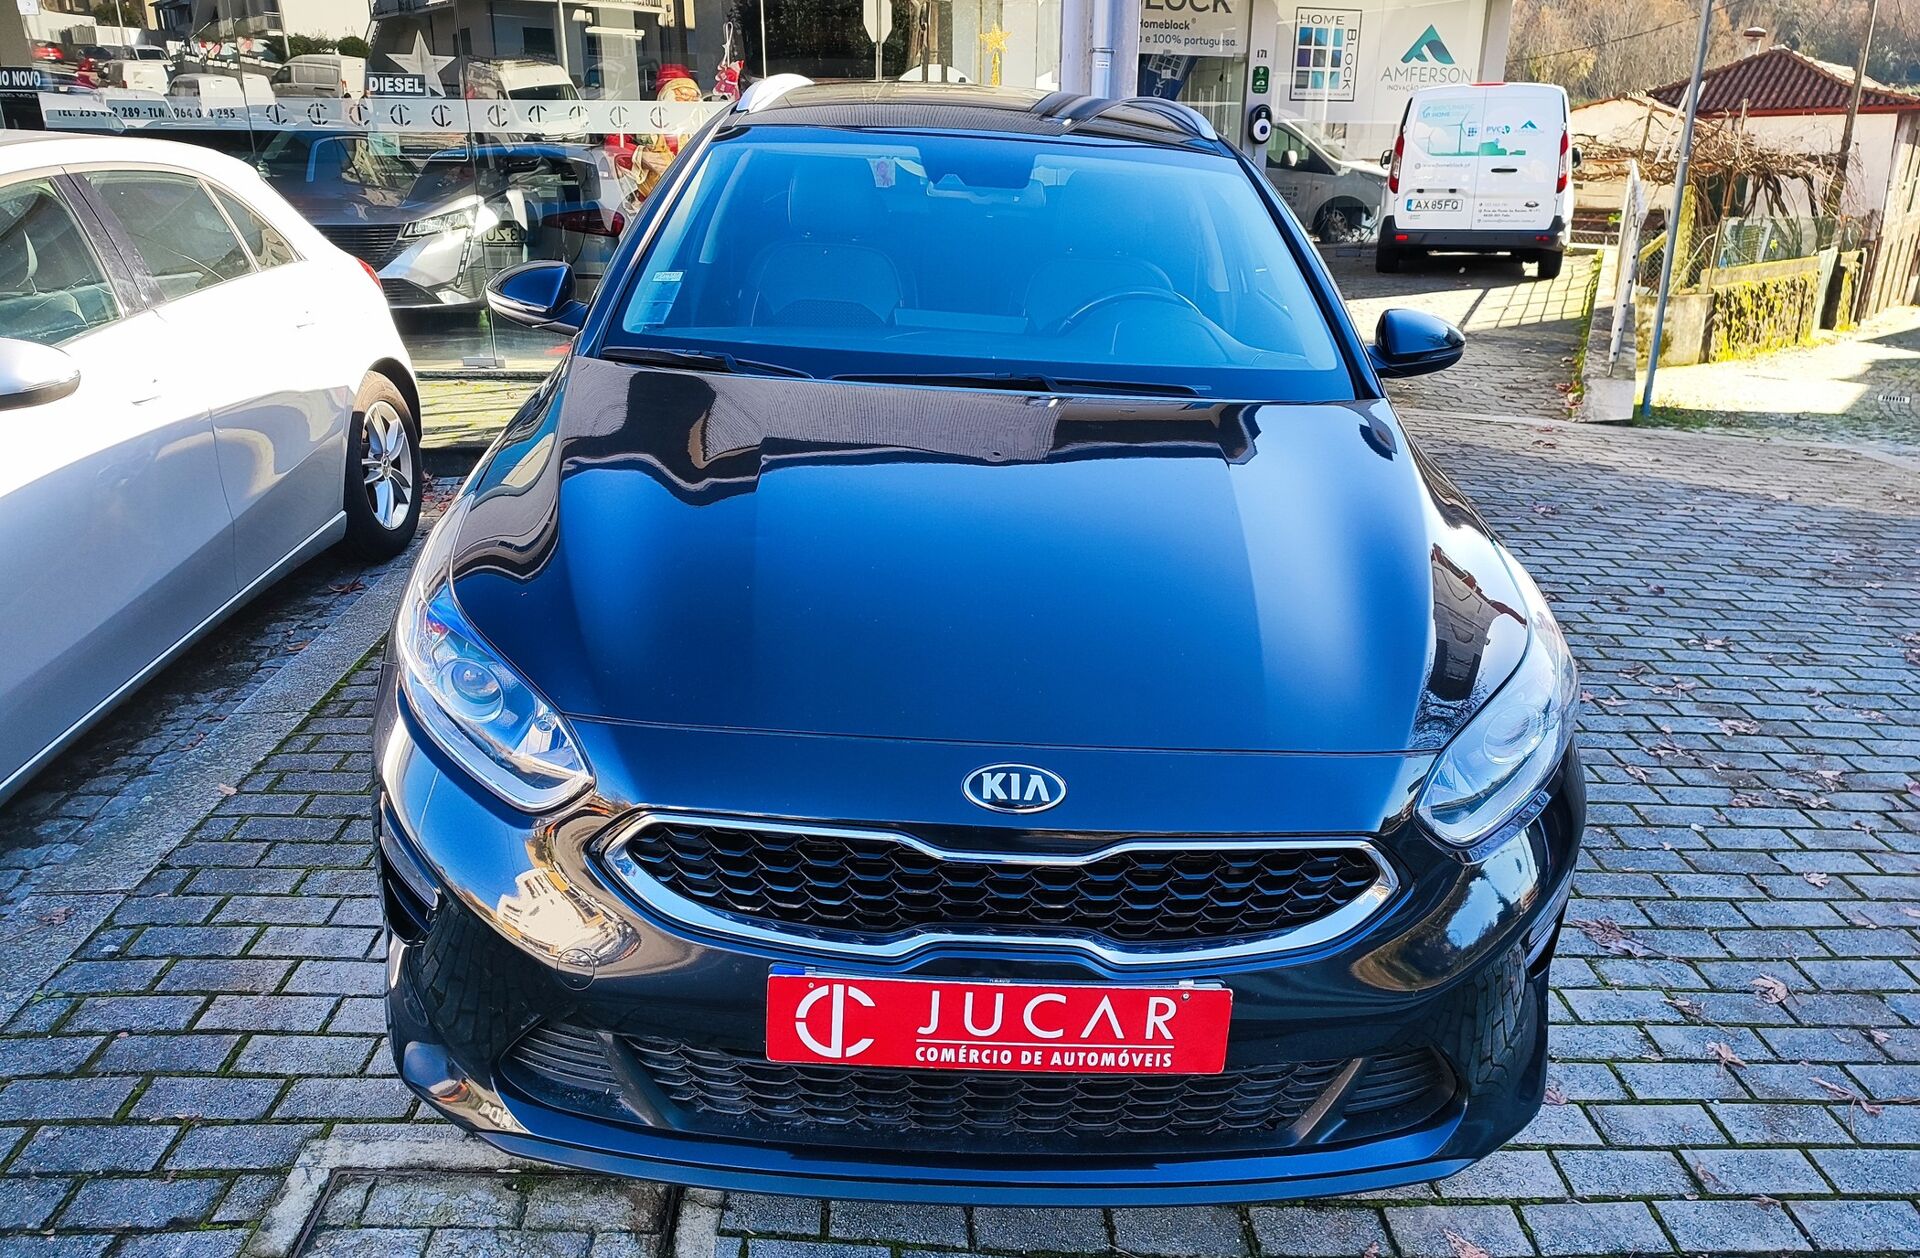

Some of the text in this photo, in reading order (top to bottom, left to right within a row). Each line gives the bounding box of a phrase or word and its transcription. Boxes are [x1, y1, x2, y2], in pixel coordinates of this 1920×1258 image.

[1300, 14, 1345, 26] HOME
[1153, 34, 1181, 44] 100%
[1342, 29, 1357, 90] BLOCK
[12, 70, 41, 87] NOVO
[1380, 66, 1473, 84] AMFERSON
[368, 76, 424, 93] DIESEL
[121, 107, 140, 118] 289
[981, 772, 1051, 802] KIA
[916, 990, 1178, 1040] JUCAR
[915, 1044, 1173, 1068] COMÉRCIO DE AUTOMÓVEIS
